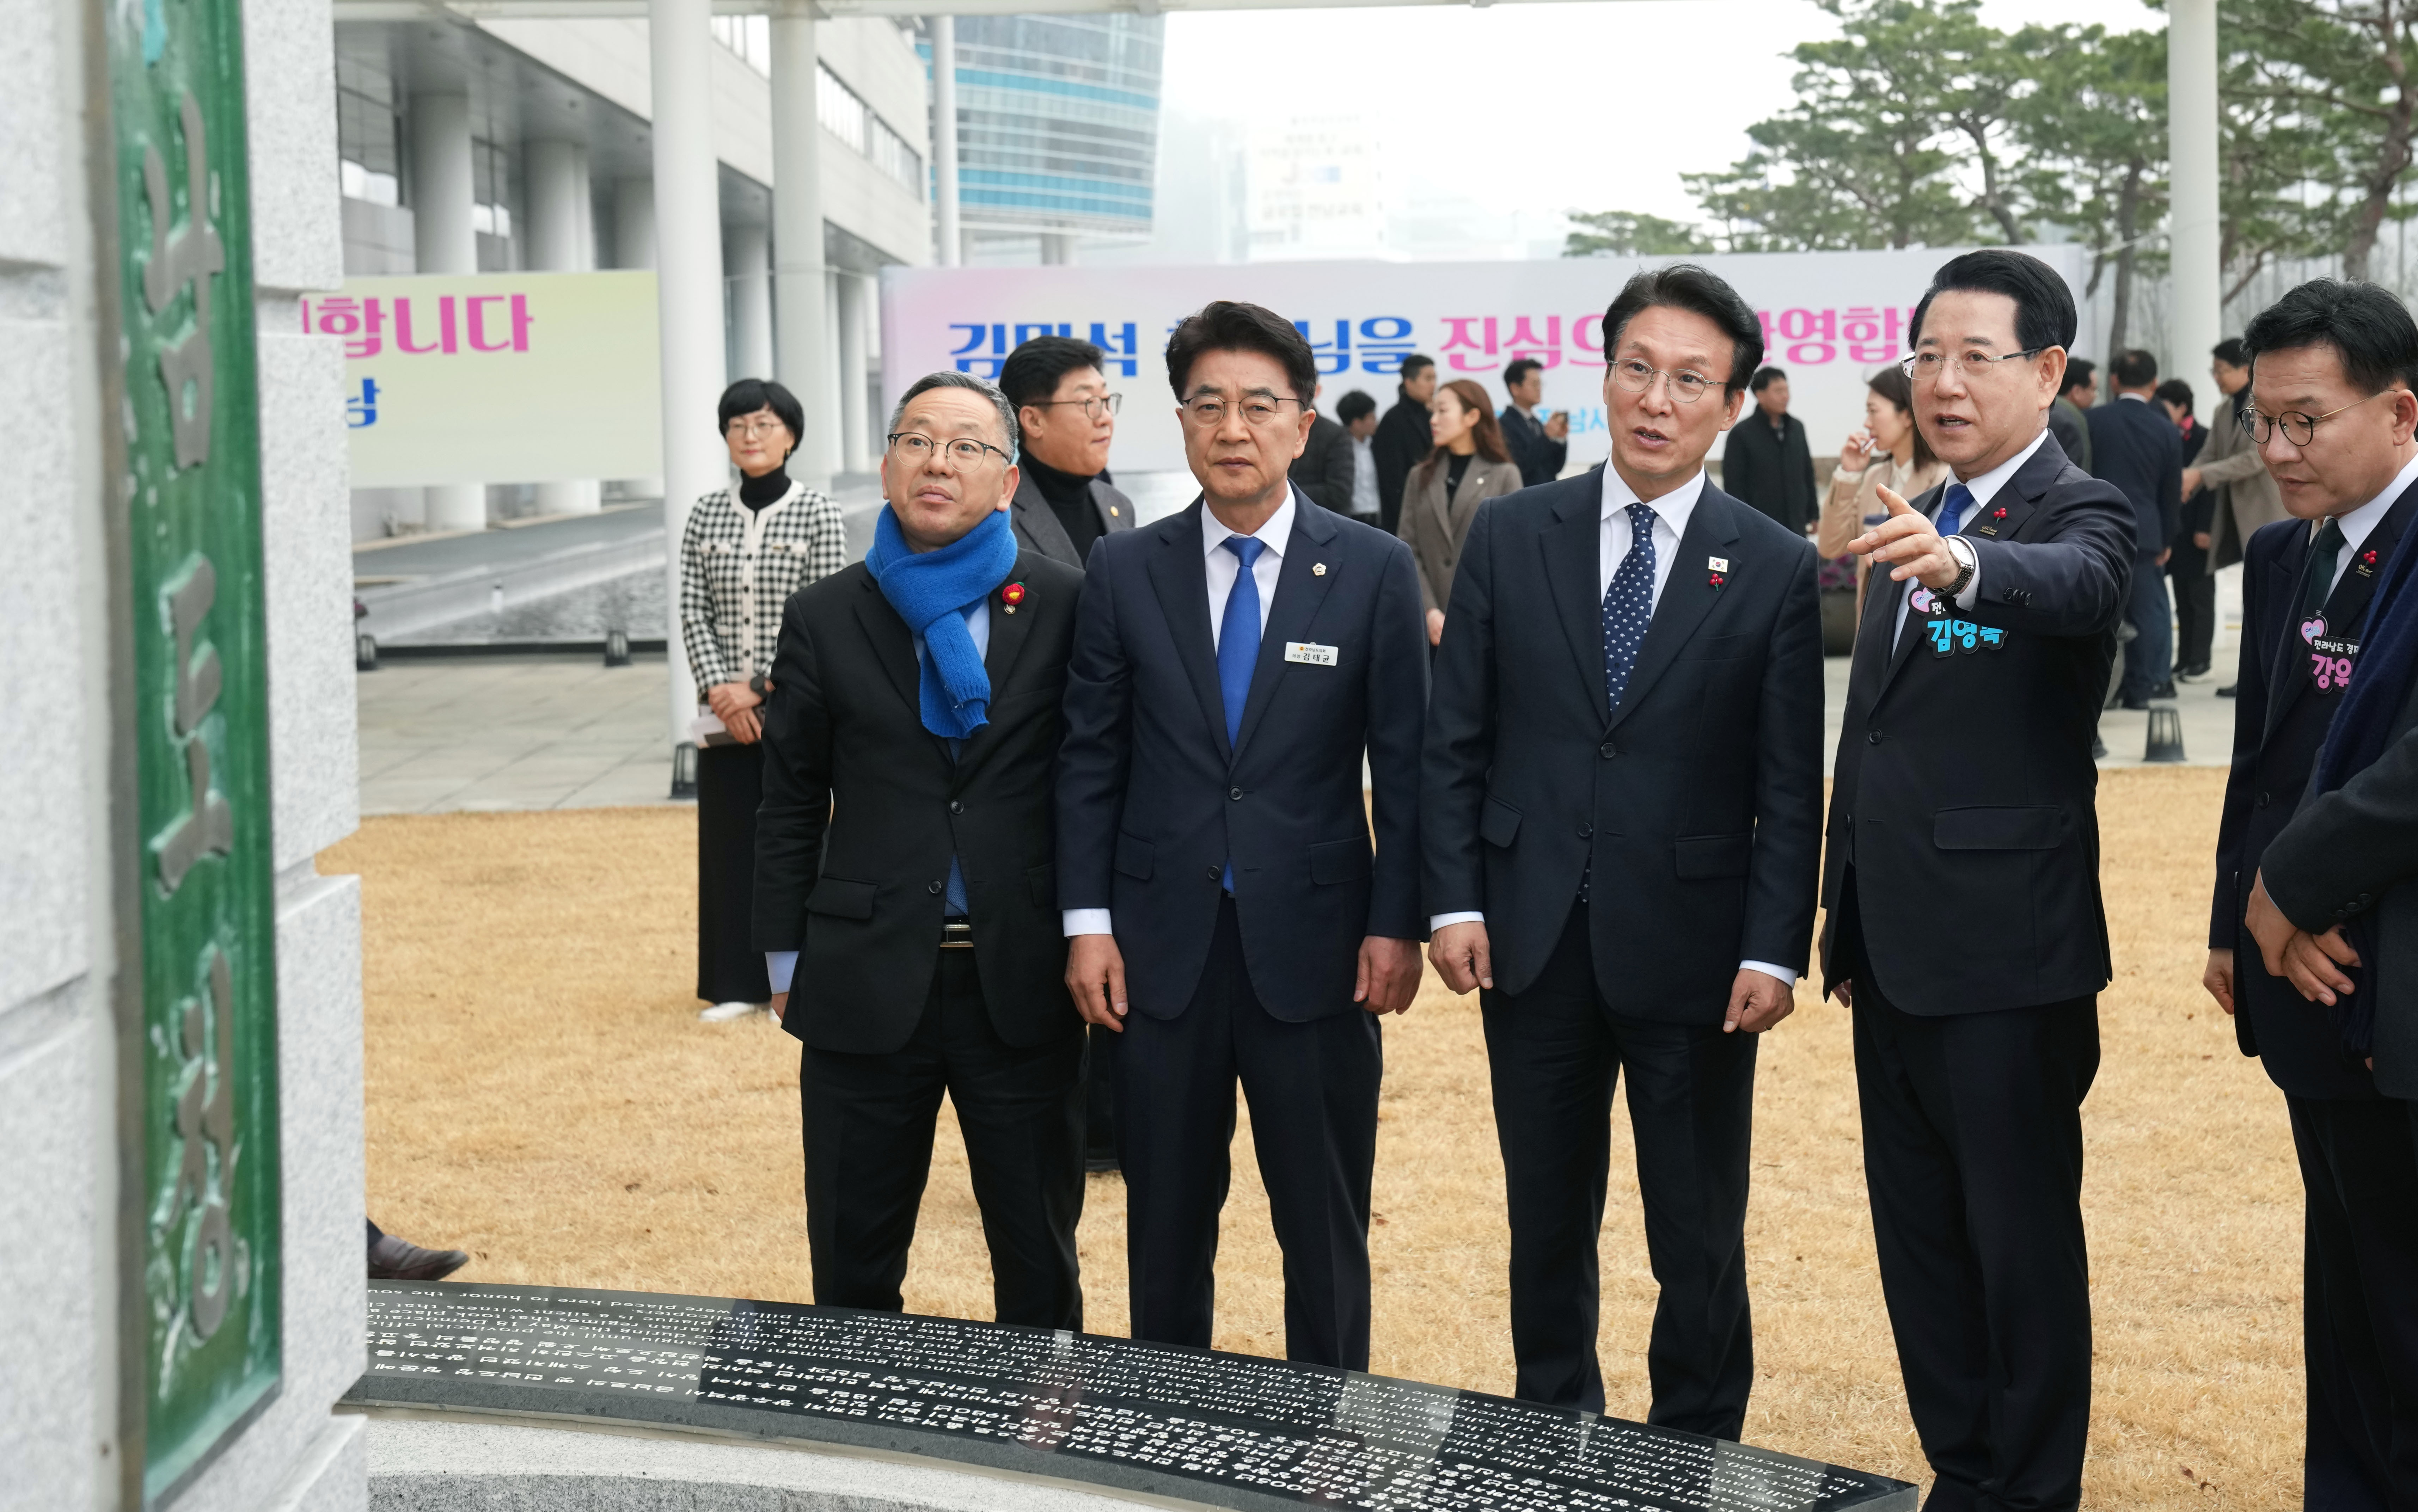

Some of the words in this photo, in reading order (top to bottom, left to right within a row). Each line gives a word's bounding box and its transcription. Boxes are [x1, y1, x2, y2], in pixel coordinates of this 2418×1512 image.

[301, 294, 534, 359] 합니다
[1439, 314, 1606, 372] 진심으
[1758, 307, 1916, 366] 영합
[1932, 602, 1946, 615] 전
[2314, 639, 2344, 652] 전라남도
[1303, 653, 1330, 663] 김태균
[459, 1292, 521, 1301] honor
[558, 1298, 601, 1306] here
[610, 1301, 677, 1310] placed
[738, 1311, 792, 1319] pillar
[797, 1322, 848, 1332] tanks
[843, 1320, 910, 1331] plaque
[853, 1328, 898, 1336] with
[917, 1328, 958, 1336] gate
[964, 1326, 1020, 1336] rights
[905, 1333, 963, 1345] forces
[965, 1333, 999, 1341] this
[1028, 1333, 1093, 1347] human
[409, 1340, 520, 1352] 지켜보았던
[537, 1341, 580, 1349] 오월
[970, 1341, 1004, 1350] law
[1010, 1345, 1079, 1358] martial
[374, 1350, 467, 1361] 광주시를
[531, 1348, 618, 1360] 고스란히
[1085, 1354, 1109, 1363] by
[374, 1363, 442, 1373] 정문에
[479, 1356, 592, 1370] 소재지였던
[628, 1356, 690, 1367] 현장을
[702, 1362, 764, 1374] 역사의
[733, 1358, 796, 1370] 기둥을
[1115, 1359, 1220, 1378] democracy
[1122, 1352, 1286, 1381] Democratization
[1244, 1363, 1296, 1374] spirit
[454, 1368, 543, 1381] 전남도청
[603, 1366, 647, 1375] 도청
[657, 1371, 699, 1381] 당시
[774, 1370, 858, 1385] 진압하던
[807, 1366, 871, 1379] 현판과
[1302, 1372, 1342, 1383] May
[586, 1378, 674, 1393] 금남로의
[711, 1376, 804, 1391] 전후하여
[868, 1381, 910, 1391] 무력
[882, 1375, 988, 1394] 전라남도청
[1226, 1375, 1255, 1384] for
[1261, 1380, 1295, 1389] call
[1349, 1379, 1378, 1388] the
[808, 1387, 878, 1401] 18일을
[1318, 1382, 1359, 1393] May
[1366, 1390, 1396, 1399] the
[685, 1388, 794, 1407] 광주광역시
[888, 1397, 925, 1408] 5월
[917, 1387, 1023, 1407] 무자비하게
[999, 1390, 1060, 1405] 당시의
[1302, 1387, 1383, 1404] people's
[1412, 1390, 1475, 1405] tribute
[803, 1402, 868, 1416] 전까지
[877, 1404, 921, 1415] 남아
[933, 1403, 1011, 1420] 1980년
[1032, 1403, 1136, 1425] 전남도민을
[1072, 1401, 1153, 1420] 기념하여
[1389, 1402, 1512, 1428] Jeollanamdo
[1430, 1401, 1542, 1425] anniversary
[1526, 1410, 1563, 1421] and
[928, 1410, 992, 1425] 자국이
[1021, 1417, 1062, 1429] 맞서
[1144, 1421, 1207, 1437] 외치던
[1165, 1416, 1261, 1437] 40주년을
[1549, 1423, 1591, 1438] 40th
[1574, 1420, 1615, 1432] May
[974, 1426, 1057, 1444] 이곳으로
[1049, 1430, 1134, 1449] 보여주는
[1180, 1436, 1220, 1448] 민중
[1598, 1433, 1629, 1443] the
[1215, 1433, 1297, 1453] 민주화를
[1541, 1430, 1655, 1457] suppression
[1648, 1434, 1712, 1453] heroes
[1066, 1441, 1173, 1465] 전남도청이
[1139, 1445, 1222, 1465] 생생하게
[1228, 1444, 1290, 1461] 일어난
[1364, 1445, 1443, 1466] 기리고자
[1636, 1440, 1715, 1461] marking
[1241, 1455, 1281, 1468] 이은
[1304, 1450, 1385, 1472] 계엄군이
[1659, 1455, 1719, 1473] brutal
[1718, 1450, 1828, 1478] democratic
[1180, 1462, 1228, 1476] 11월
[1231, 1462, 1291, 1479] 상황을
[1300, 1458, 1385, 1479] 요구하며
[1454, 1463, 1513, 1480] 정신을
[1725, 1470, 1756, 1480] the
[1235, 1473, 1316, 1494] 2005년
[1299, 1476, 1360, 1494] 당시의
[1394, 1469, 1457, 1487] 동원한
[1522, 1477, 1565, 1490] 오월
[1780, 1474, 1821, 1487] May
[1834, 1477, 1865, 1487] the
[1390, 1477, 1494, 1505] 민주주의를
[1481, 1478, 1563, 1501] 2020년
[1763, 1479, 1831, 1498] depicts
[1828, 1485, 1847, 1494] In
[1370, 1492, 1463, 1512] 주화운동
[1383, 1485, 1469, 1509] 신군부의
[1569, 1498, 1611, 1512] 이에
